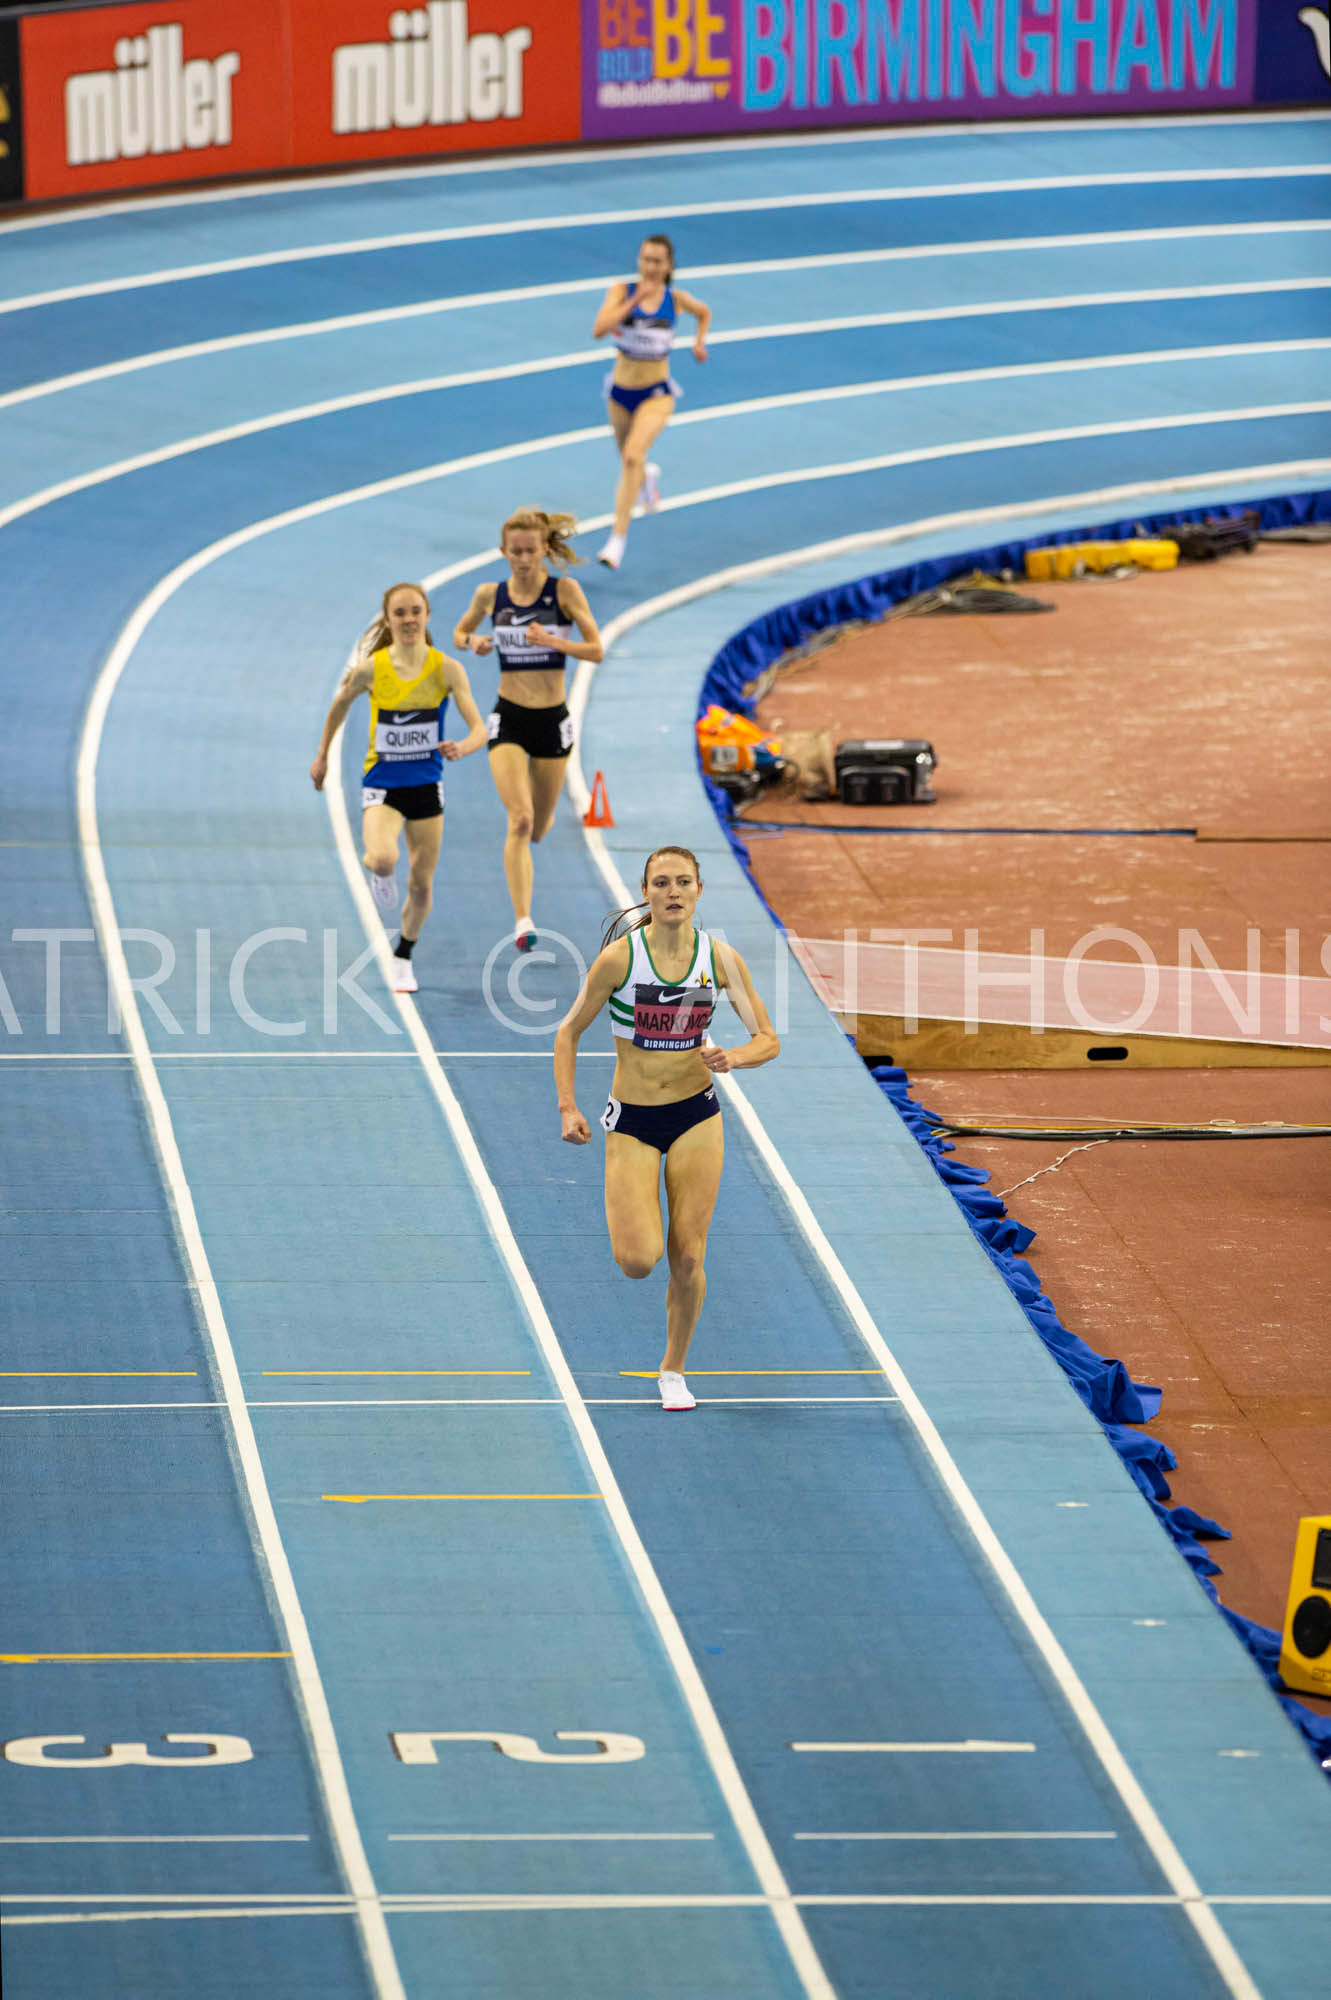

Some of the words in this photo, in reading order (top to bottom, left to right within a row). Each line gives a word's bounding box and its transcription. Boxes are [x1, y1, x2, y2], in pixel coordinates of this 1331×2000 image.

[333, 0, 531, 134] müller
[655, 0, 731, 78] BE
[742, 0, 1238, 113] BIRMINGHAM
[65, 22, 240, 166] müller
[386, 729, 430, 746] QUIRK
[643, 1038, 696, 1050] BIRMINGHAM
[4, 1733, 254, 1768] 3
[389, 1731, 646, 1765] 2
